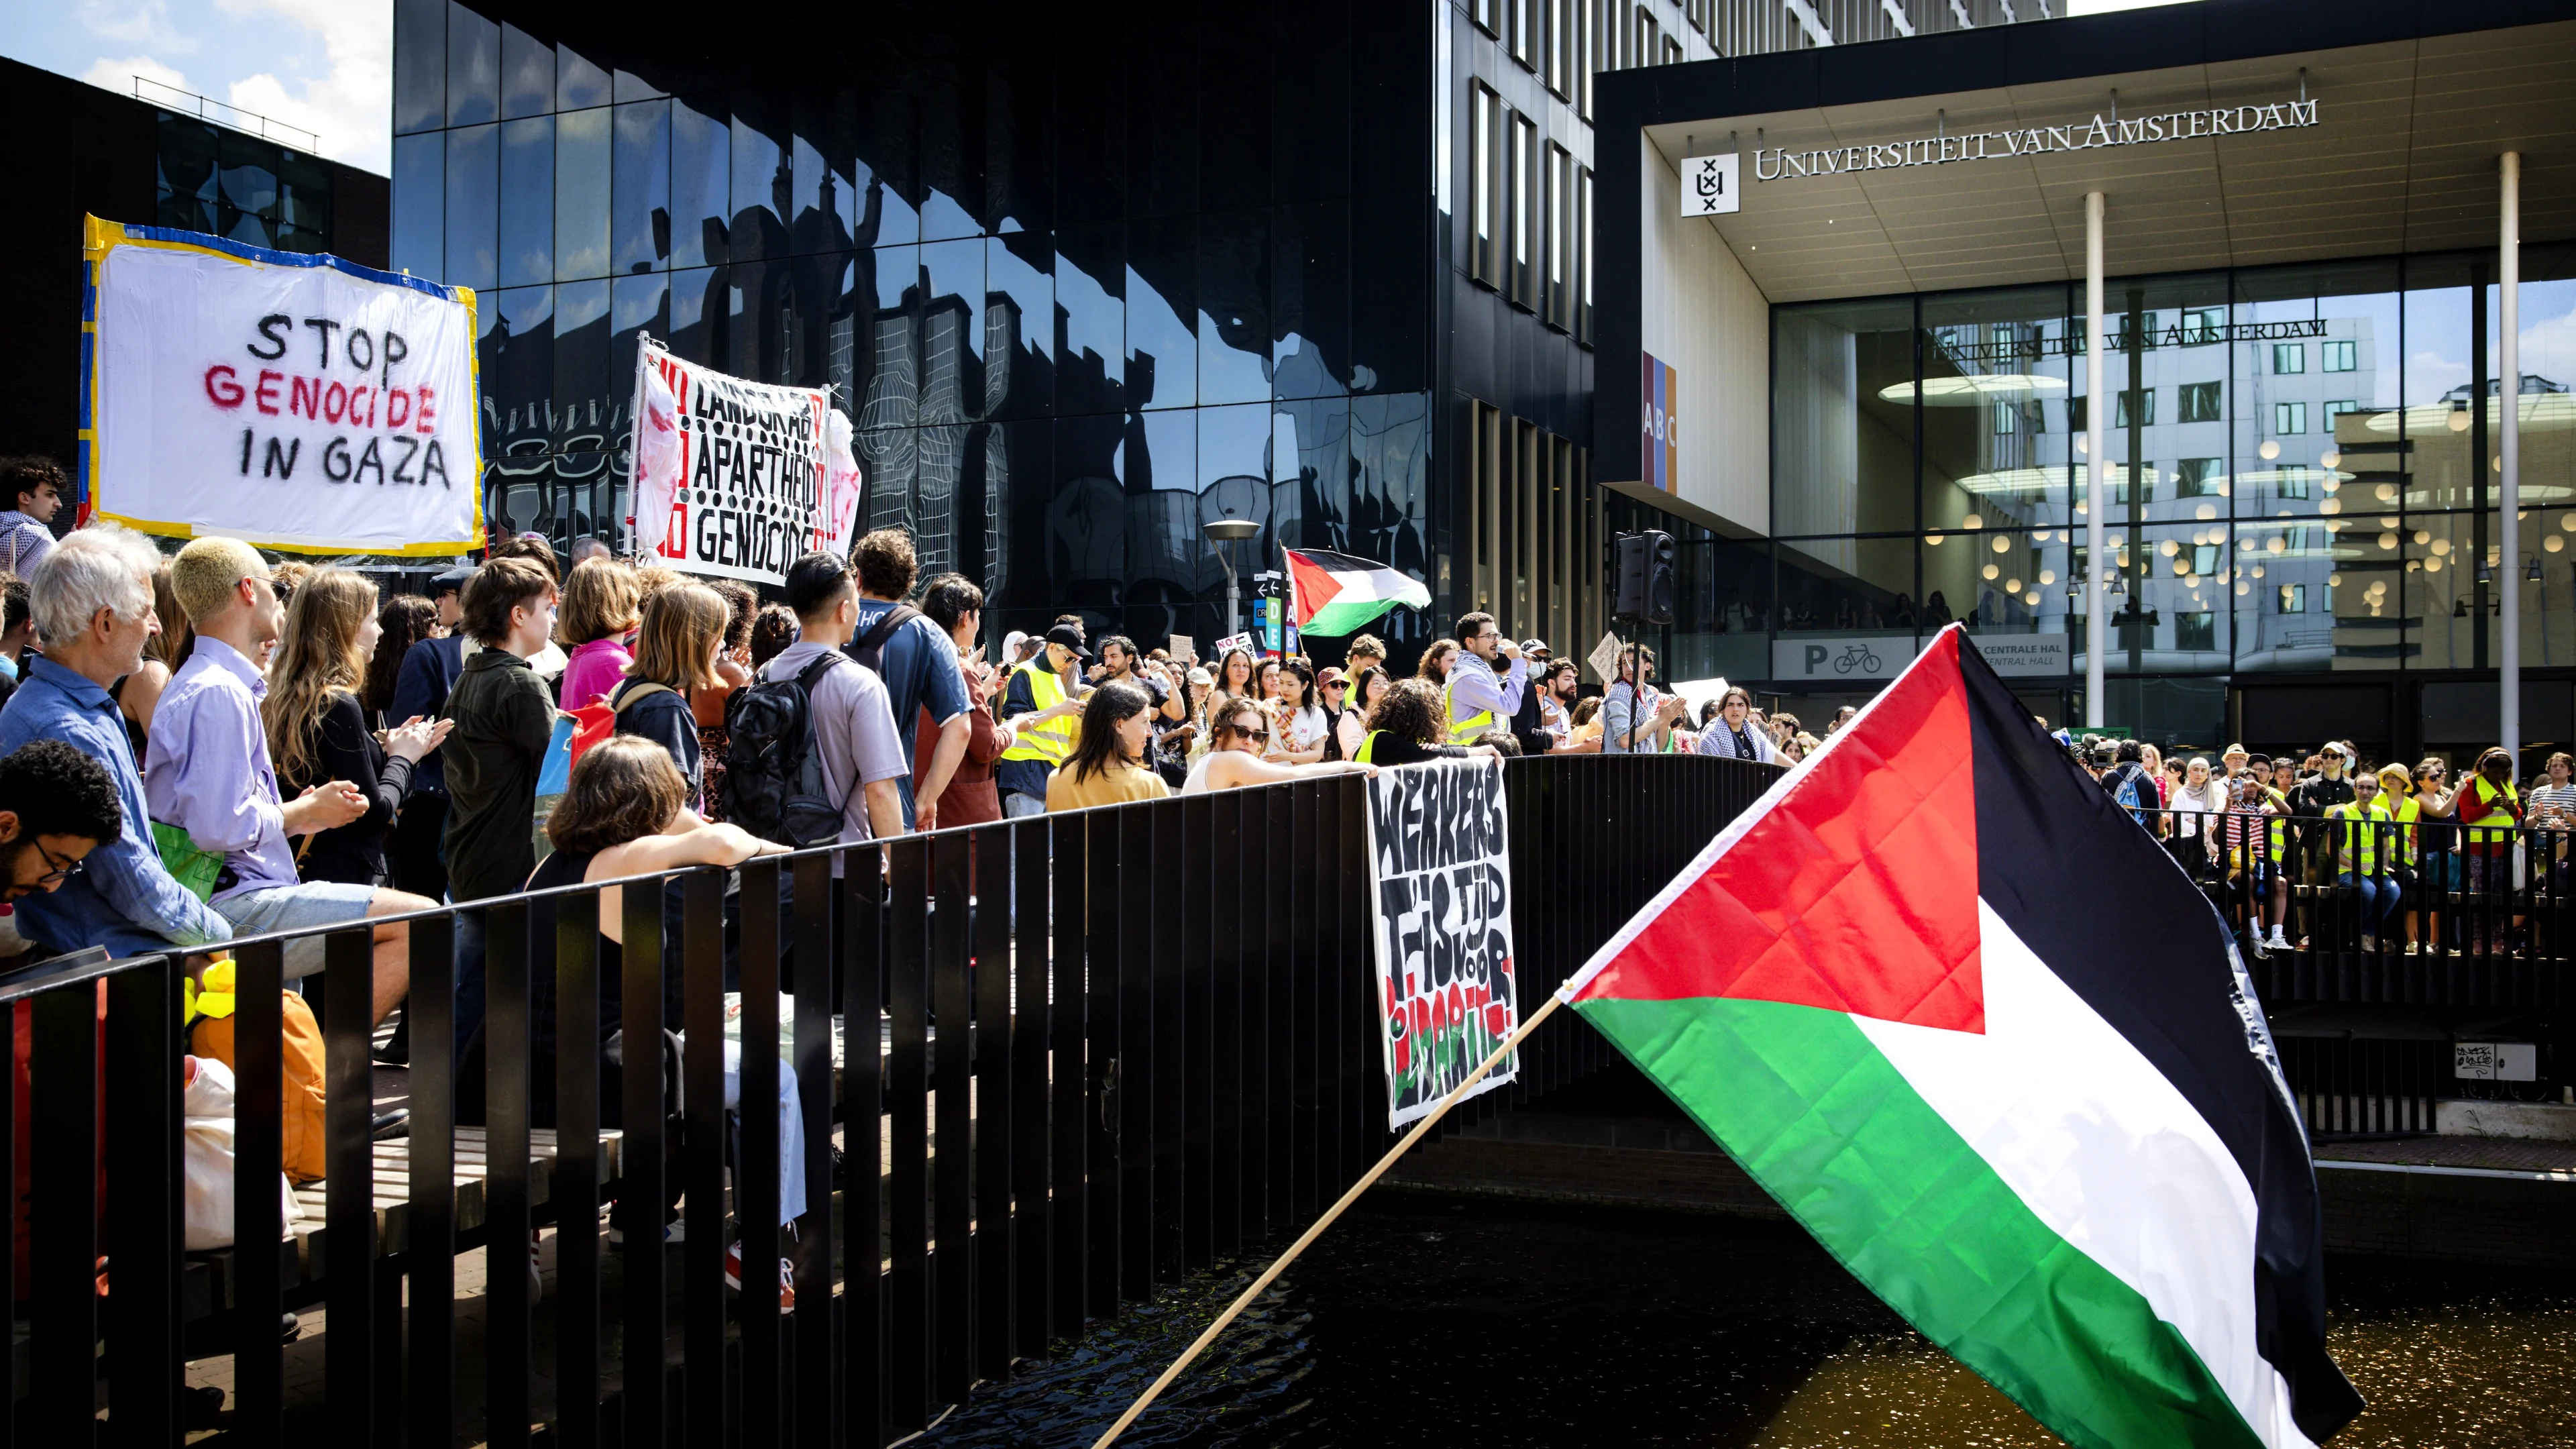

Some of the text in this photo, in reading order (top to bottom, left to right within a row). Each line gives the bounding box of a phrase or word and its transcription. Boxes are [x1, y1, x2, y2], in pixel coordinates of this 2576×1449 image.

[1753, 99, 2320, 181] UNIVERSITEIT VAN AMSTERDAM
[247, 313, 408, 392] STOP
[205, 364, 436, 434] GENOCIDE
[241, 427, 451, 490] IN GAZA
[1218, 638, 1233, 649] NO
[1984, 645, 2037, 654] CENTRALE
[2041, 645, 2062, 653] HAL
[2029, 657, 2054, 665] HALL
